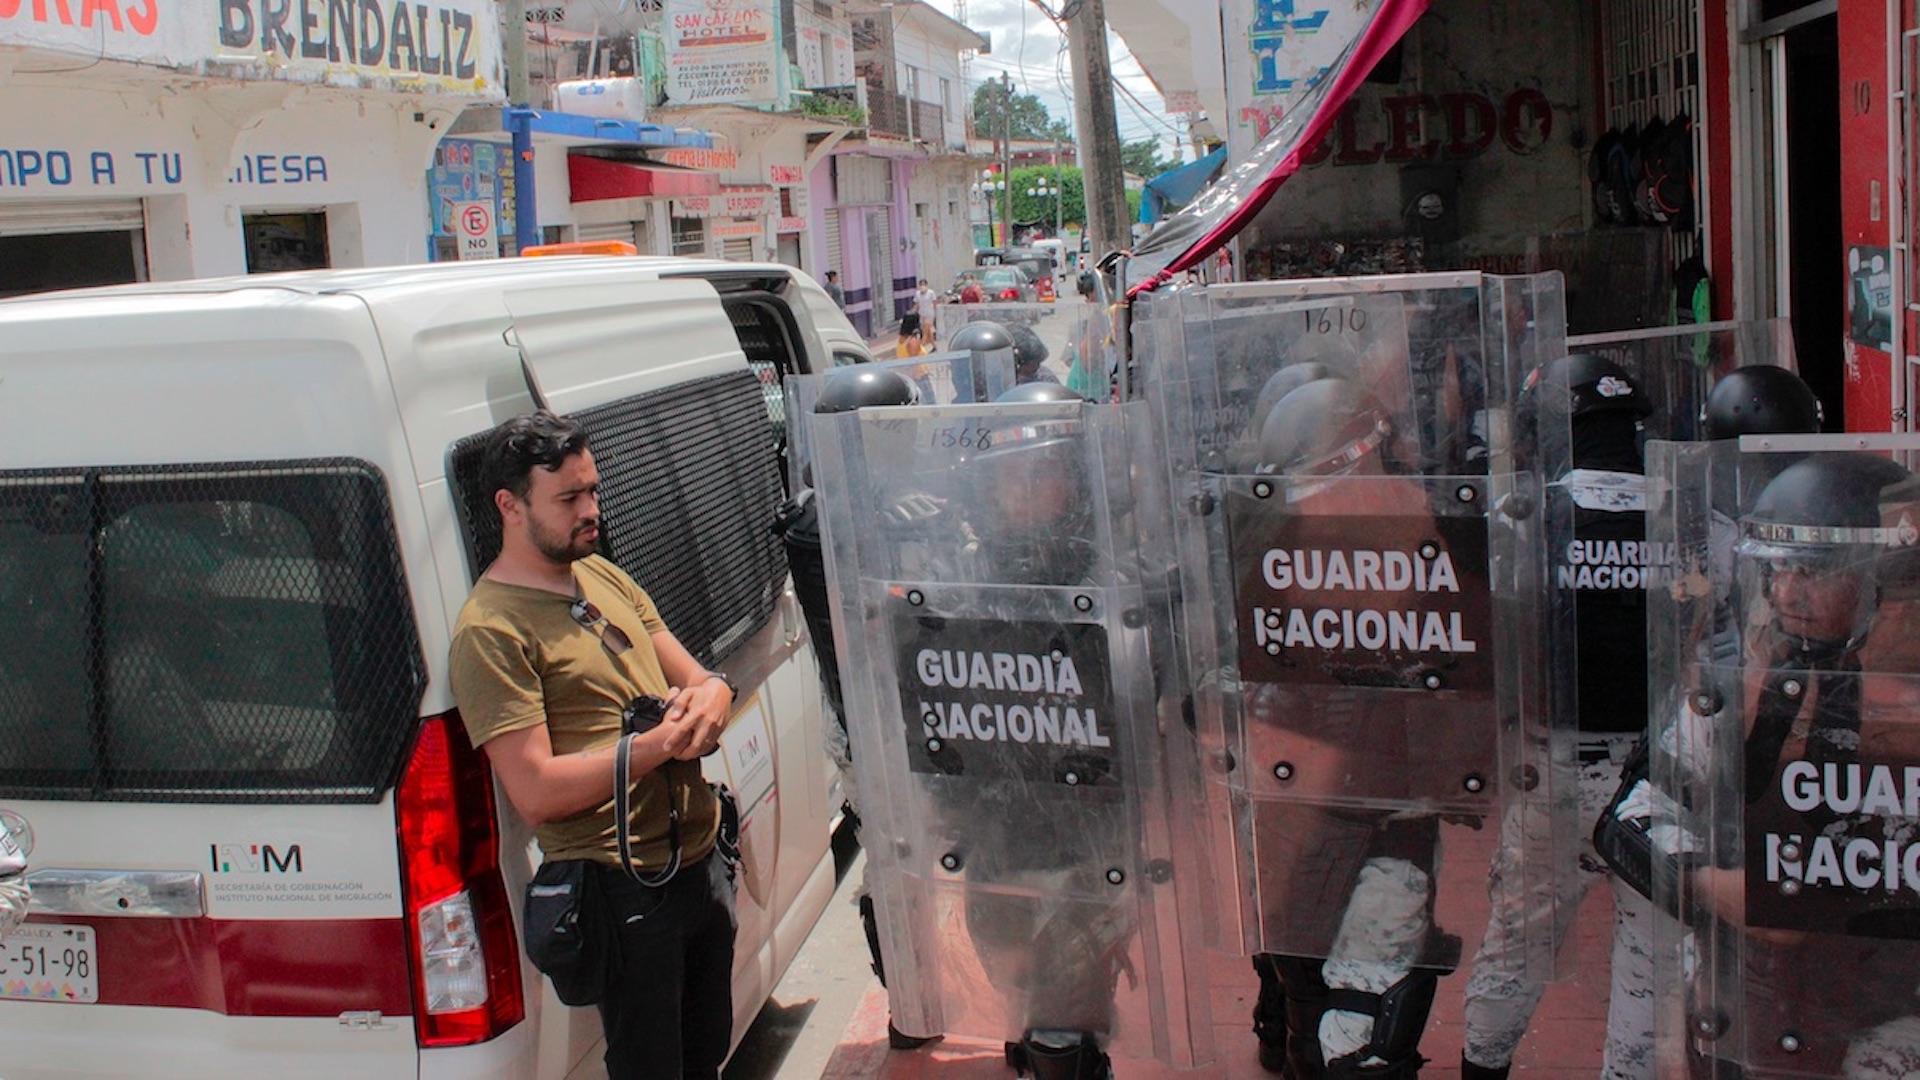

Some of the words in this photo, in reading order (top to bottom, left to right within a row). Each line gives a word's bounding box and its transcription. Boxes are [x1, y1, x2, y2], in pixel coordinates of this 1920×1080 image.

[674, 13, 701, 29] SAN
[682, 25, 758, 37] HOTEL
[217, 0, 476, 80] BRENDALIZ
[90, 152, 116, 185] A
[135, 152, 183, 184] TU
[468, 239, 488, 249] NO
[1304, 307, 1367, 334] 1610
[930, 427, 992, 451] 1568
[1261, 548, 1460, 593] GUARDIA
[1557, 565, 1673, 590] NACIONA
[1252, 607, 1477, 653] NACIONAL
[915, 648, 1084, 696] GUARDIA
[919, 701, 1112, 748] NACIONAL
[210, 843, 303, 873] INM
[214, 881, 271, 892] SECRETARÍA
[274, 883, 288, 891] DE
[290, 881, 364, 892] GOBERNACIÓN
[215, 893, 264, 903] INSTITUTO
[266, 893, 316, 902] NACIONAL
[318, 893, 332, 902] DE
[333, 892, 393, 902] MIGRACIÓN
